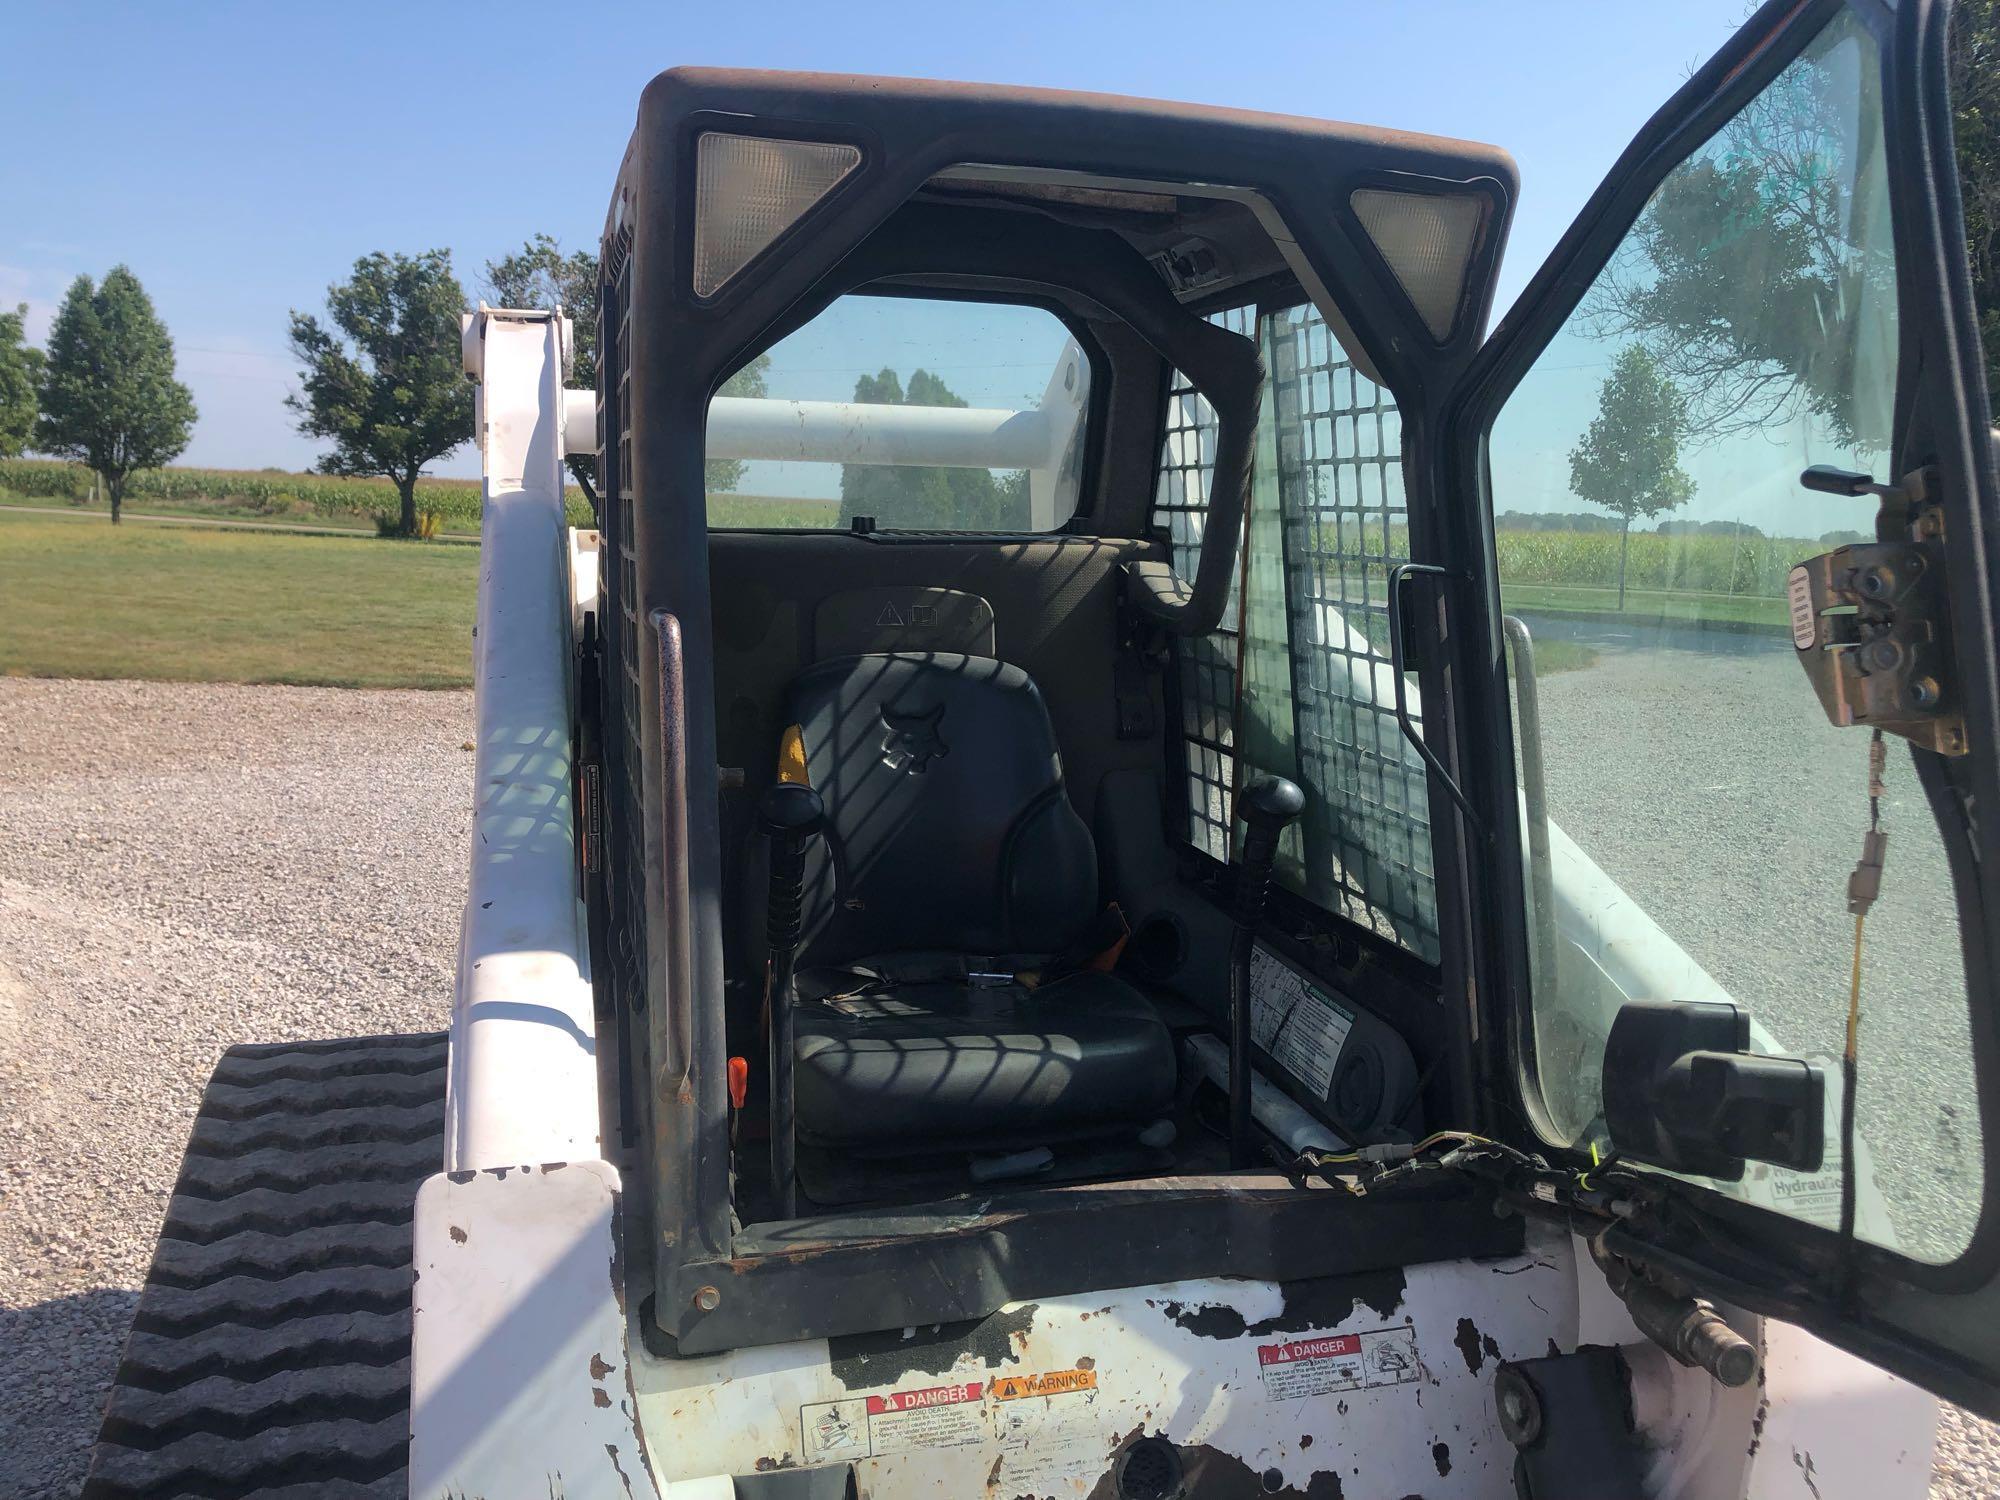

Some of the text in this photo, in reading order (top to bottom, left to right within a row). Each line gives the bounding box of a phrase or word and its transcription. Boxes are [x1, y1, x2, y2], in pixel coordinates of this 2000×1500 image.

[1294, 1340, 1345, 1358] DANGER
[1024, 1374, 1089, 1392] WARNING
[905, 1387, 968, 1407] DANGER
[906, 1406, 949, 1417] AVOID DEATH
